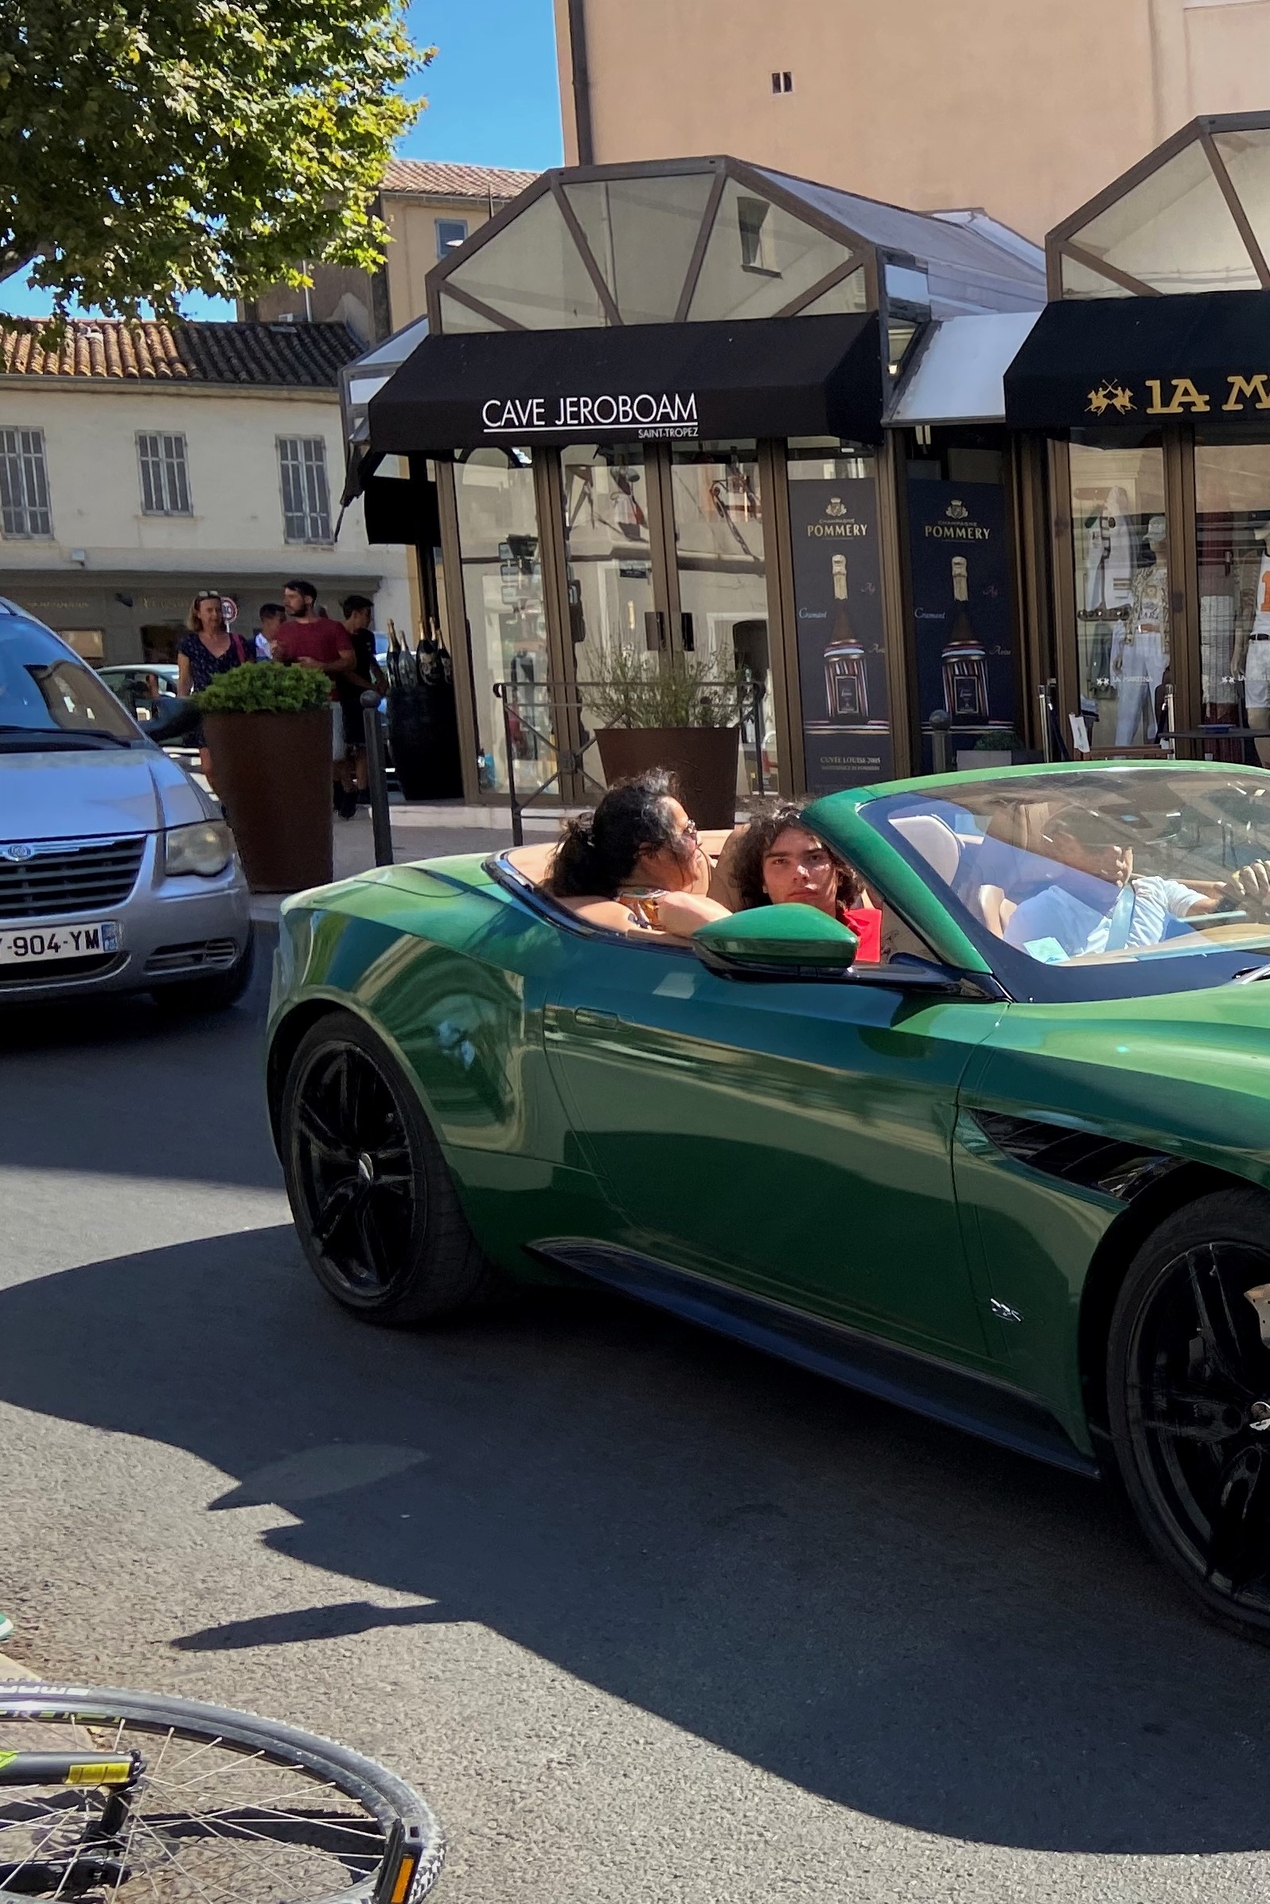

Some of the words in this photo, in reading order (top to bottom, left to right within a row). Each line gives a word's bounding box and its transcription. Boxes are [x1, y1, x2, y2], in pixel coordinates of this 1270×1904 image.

[1144, 379, 1210, 415] LA
[482, 399, 546, 428] CAVE
[554, 392, 698, 426] JEROBOAM
[638, 426, 699, 439] SAINT-TROPEZ
[807, 524, 868, 537] POMMERY
[925, 525, 991, 540] POMMERY
[0, 928, 99, 957] -904-YM
